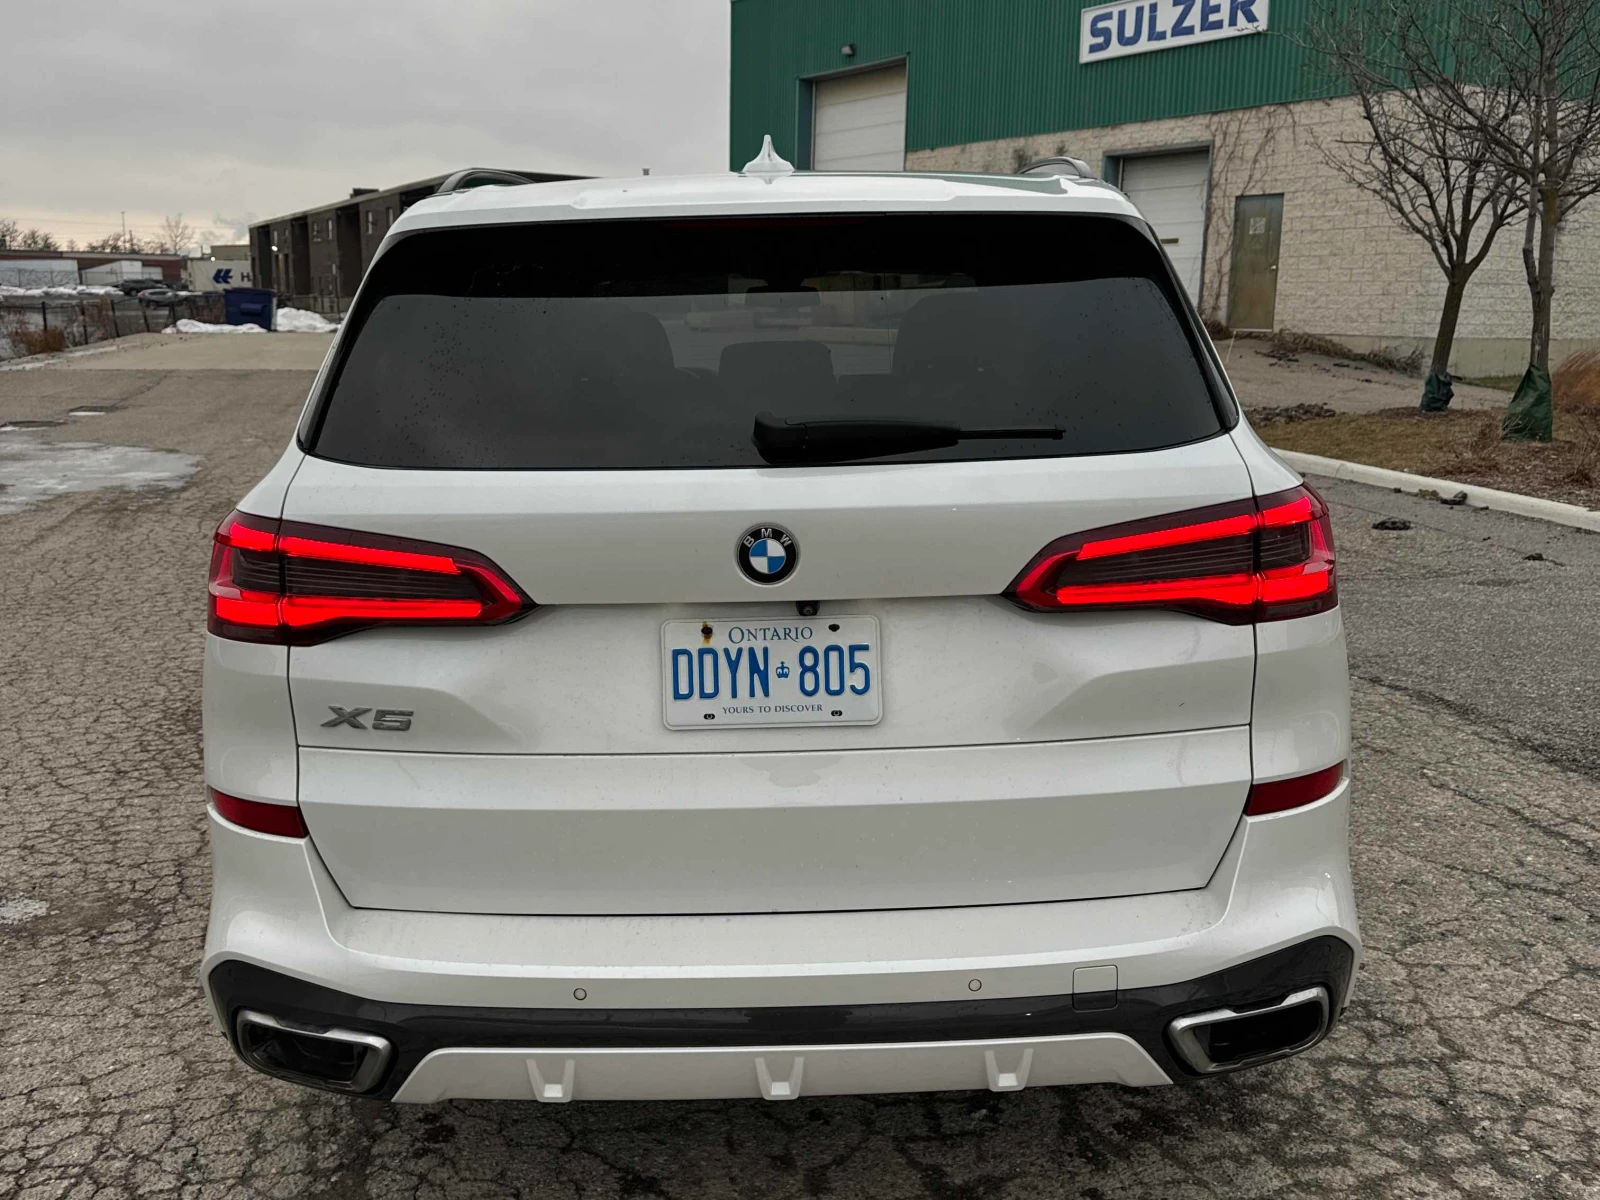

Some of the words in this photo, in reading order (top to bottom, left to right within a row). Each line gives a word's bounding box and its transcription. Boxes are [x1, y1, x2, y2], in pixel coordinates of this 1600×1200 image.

[1088, 0, 1259, 54] SULZER
[743, 528, 792, 548] BMW
[728, 626, 813, 645] ONTARIO
[671, 646, 770, 700] DDYN
[798, 644, 871, 697] 805
[320, 704, 414, 731] X5
[722, 706, 754, 715] YOURS
[757, 705, 772, 714] TO
[774, 703, 824, 713] DISCOVER
